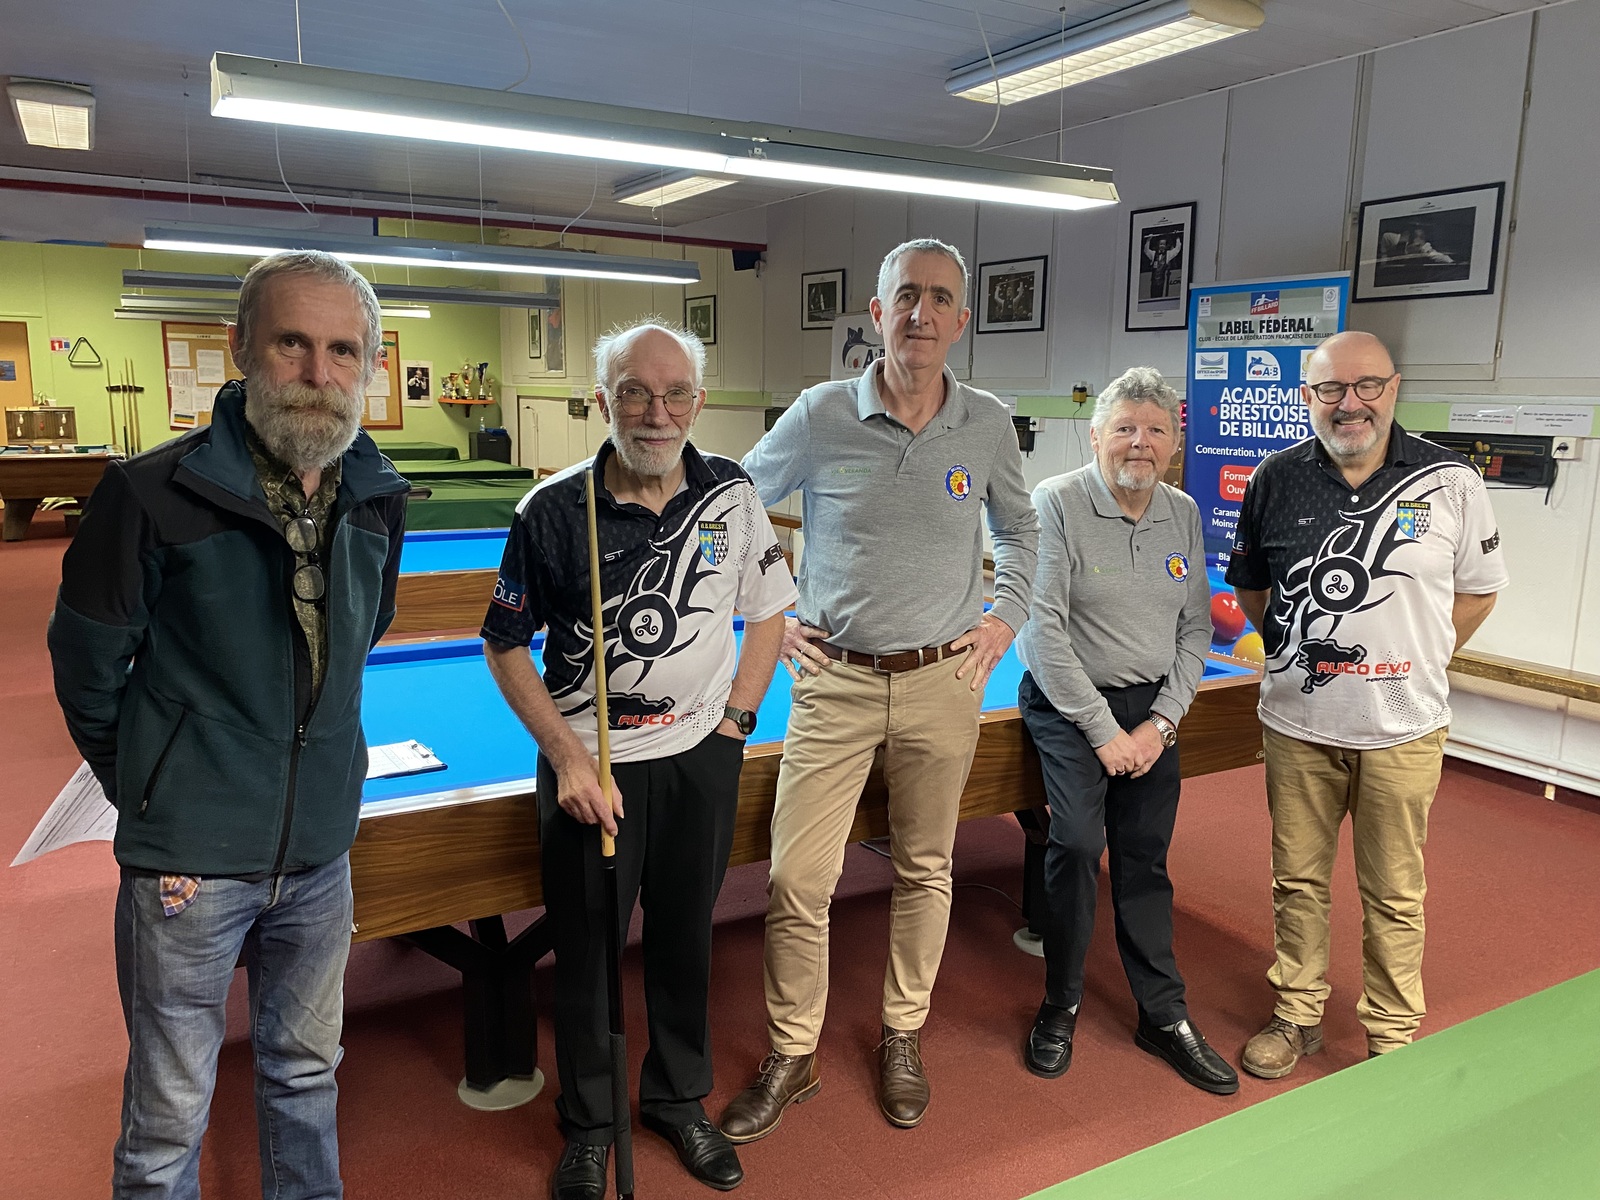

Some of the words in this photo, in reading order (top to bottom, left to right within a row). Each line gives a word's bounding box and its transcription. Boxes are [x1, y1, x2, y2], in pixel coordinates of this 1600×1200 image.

[1219, 321, 1255, 335] LABEL
[1259, 316, 1314, 333] FÉDÉRAL
[1244, 333, 1275, 341] FÉDÉRATION
[1220, 404, 1308, 422] BRESTOISE
[1220, 422, 1240, 436] DE
[1242, 422, 1309, 439] BILLARD
[1195, 444, 1257, 458] Concentration.
[1213, 507, 1241, 518] Caramb
[1211, 518, 1234, 529] Moins
[1375, 661, 1411, 675] EVO
